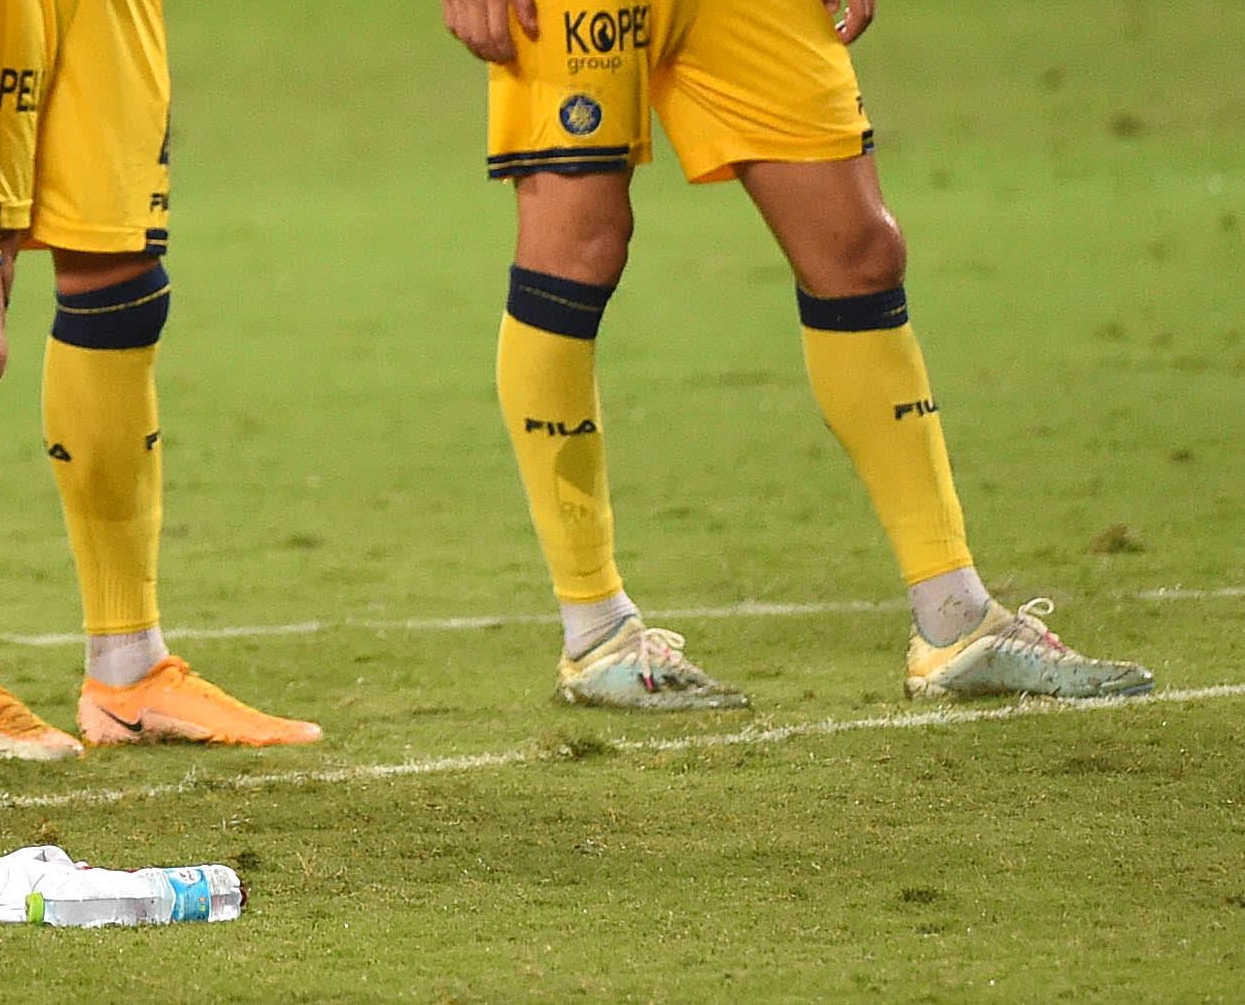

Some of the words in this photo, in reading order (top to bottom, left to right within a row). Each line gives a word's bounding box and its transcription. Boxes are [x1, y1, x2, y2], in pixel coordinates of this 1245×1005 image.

[567, 56, 622, 75] group
[894, 399, 939, 420] FIL
[525, 418, 597, 436] FILA
